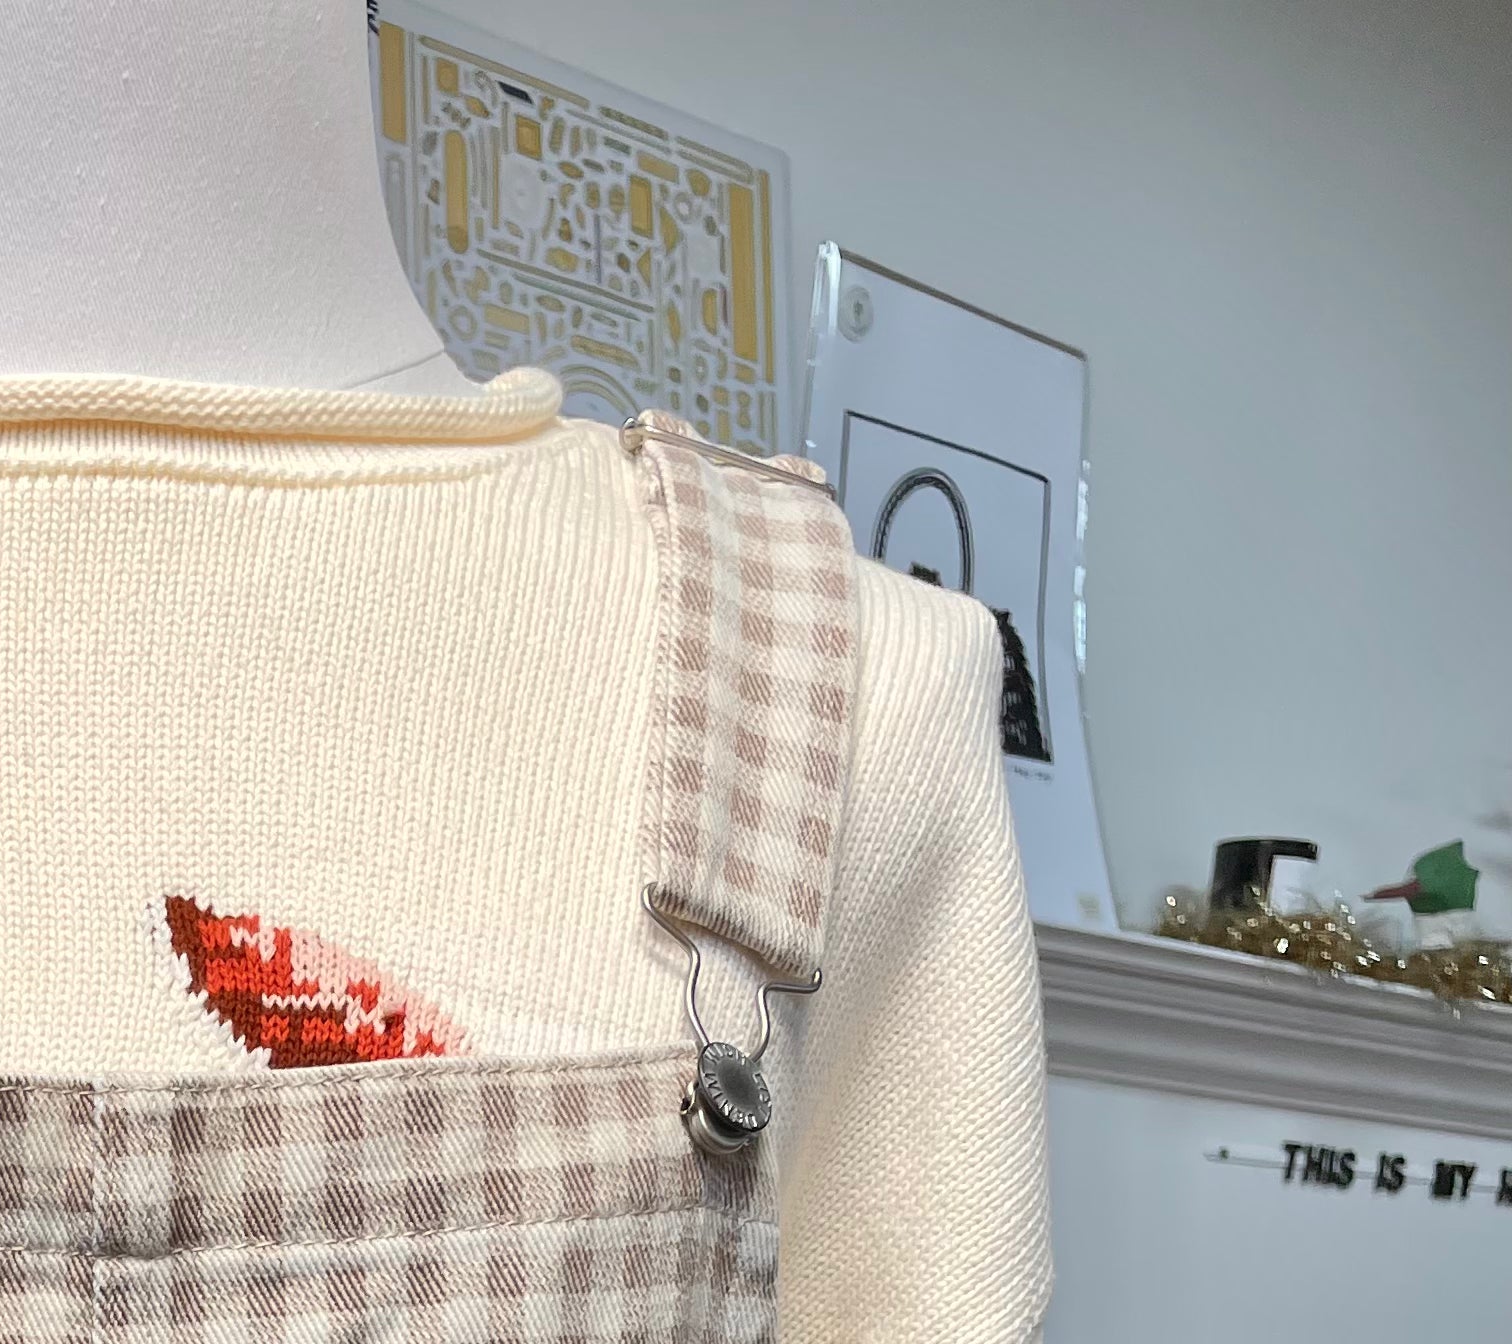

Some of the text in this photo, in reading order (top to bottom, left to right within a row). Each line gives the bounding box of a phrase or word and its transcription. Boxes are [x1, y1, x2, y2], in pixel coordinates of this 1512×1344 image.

[1281, 1140, 1357, 1190] THIS
[1374, 1152, 1406, 1193] IS
[1430, 1158, 1479, 1202] MY
